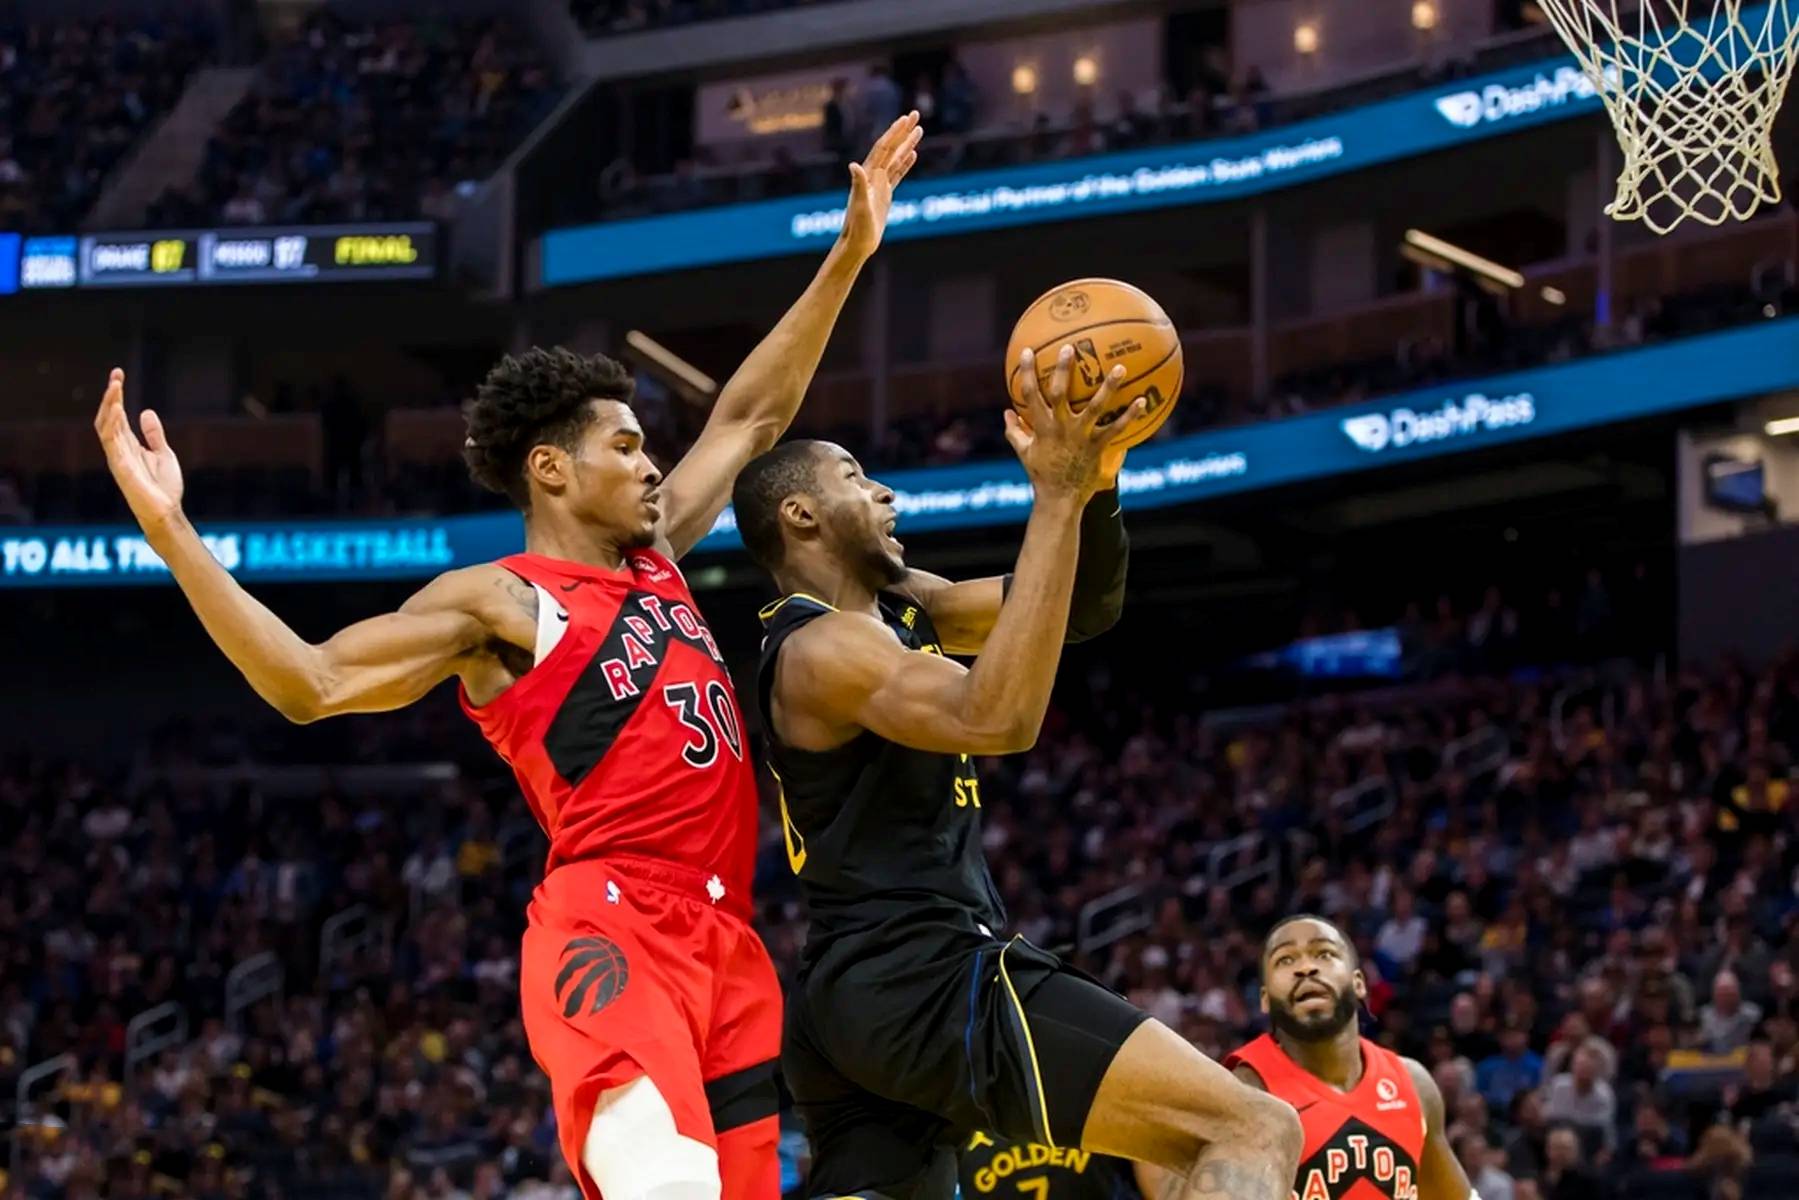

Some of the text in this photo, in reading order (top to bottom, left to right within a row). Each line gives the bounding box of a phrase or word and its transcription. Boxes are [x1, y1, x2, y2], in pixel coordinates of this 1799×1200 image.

[1482, 64, 1619, 121] DashPas
[922, 189, 990, 220] Official
[993, 184, 1067, 210] Partner
[1072, 174, 1096, 201] of
[1098, 172, 1130, 197] the
[1133, 164, 1207, 193] Golden
[1263, 136, 1343, 170] Warriors
[335, 235, 417, 265] FINAL
[1391, 392, 1535, 447] DashPass
[2, 538, 48, 575] TO
[51, 537, 109, 572] ALL
[246, 528, 453, 570] BASKETBALL
[600, 595, 734, 700] RAPTOR
[663, 680, 743, 768] 30
[973, 1142, 1091, 1193] GOLDEN
[1291, 1135, 1418, 1200] APTOR
